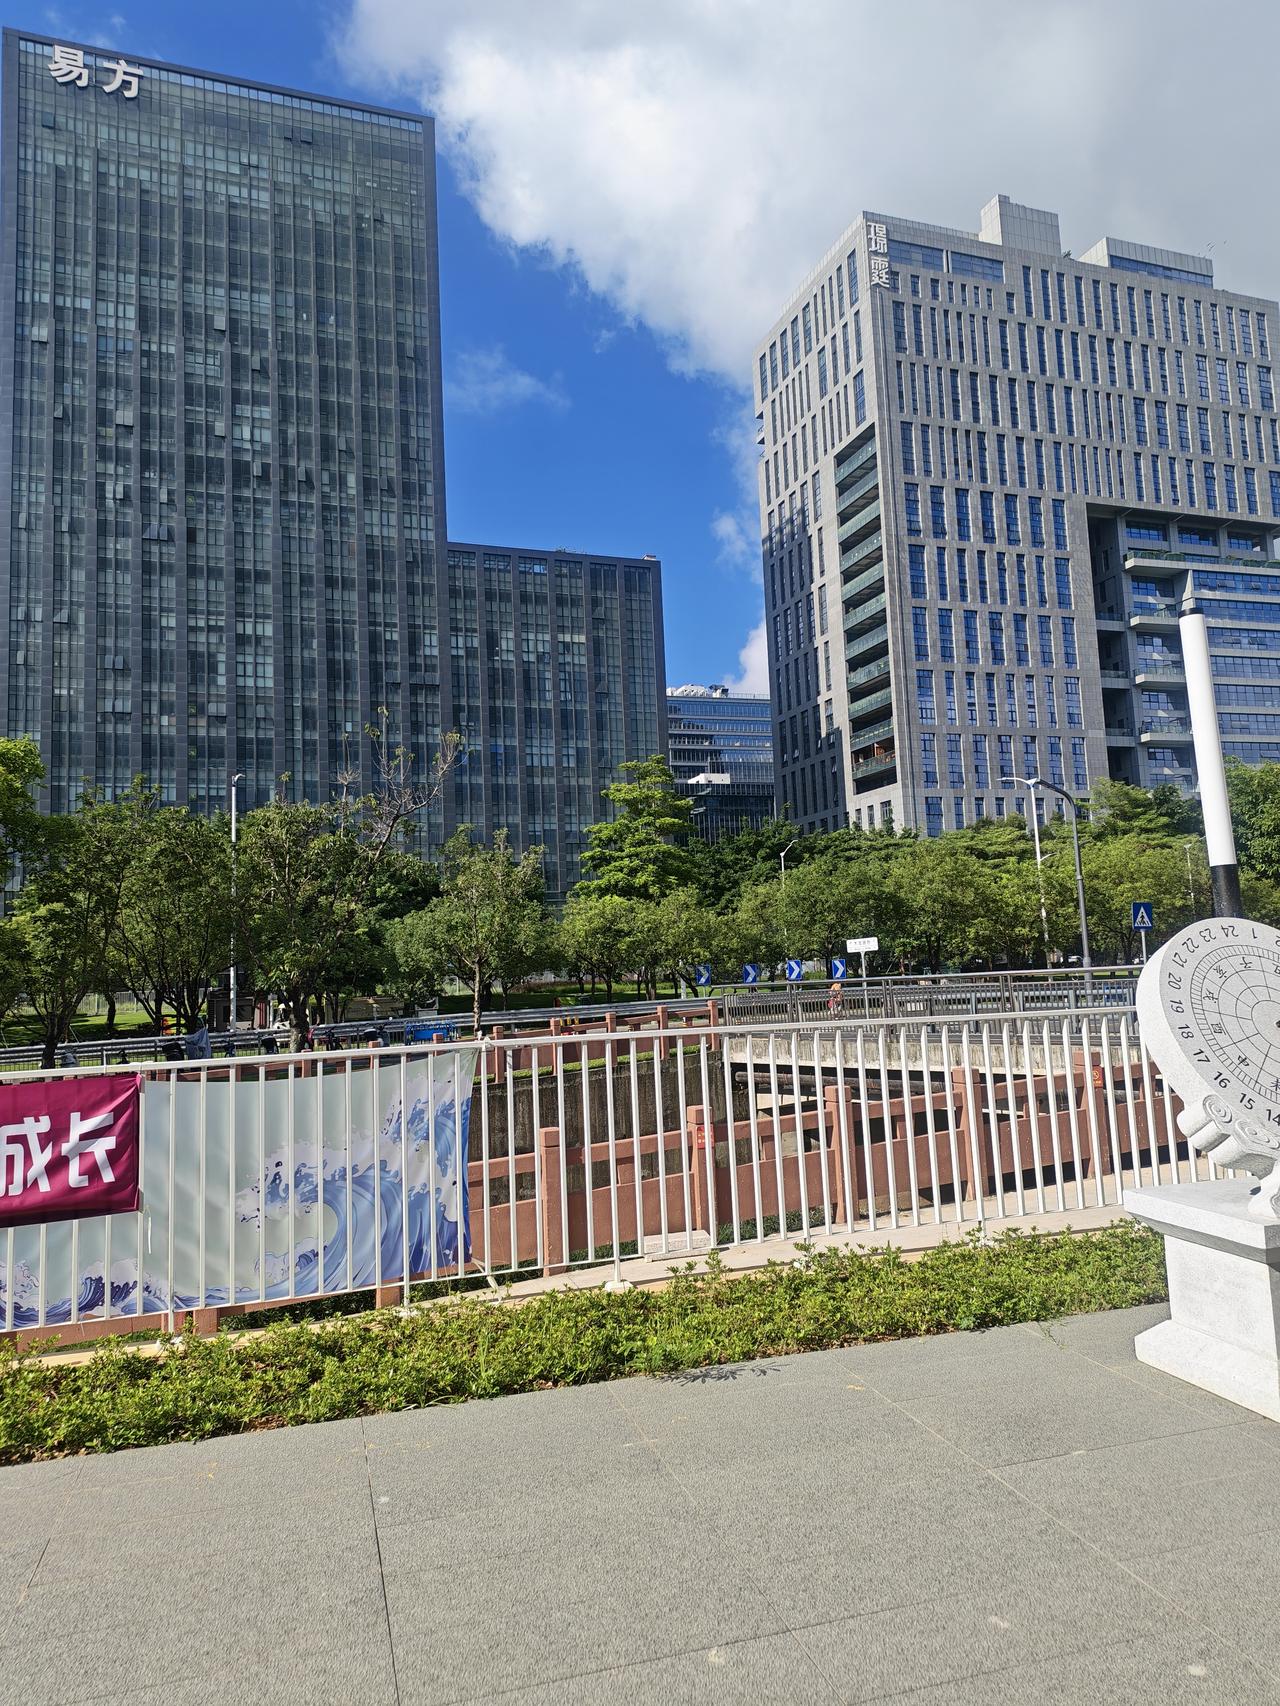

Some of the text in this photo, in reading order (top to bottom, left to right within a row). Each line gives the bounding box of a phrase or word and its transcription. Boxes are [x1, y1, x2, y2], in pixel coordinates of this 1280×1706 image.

[47, 44, 144, 98] 易方
[1199, 927, 1217, 942] 23
[1220, 924, 1239, 938] 24
[1251, 927, 1258, 939] 1
[1182, 937, 1200, 953] 22
[1172, 952, 1188, 968] 21
[1239, 956, 1253, 969] 子
[1168, 971, 1182, 990] 20
[1169, 999, 1184, 1014] 19
[1177, 1023, 1195, 1039] 18
[1193, 1048, 1211, 1063] 17
[1213, 1070, 1231, 1089] 16
[1239, 1092, 1256, 1110] 15
[0, 1112, 117, 1197] 成长
